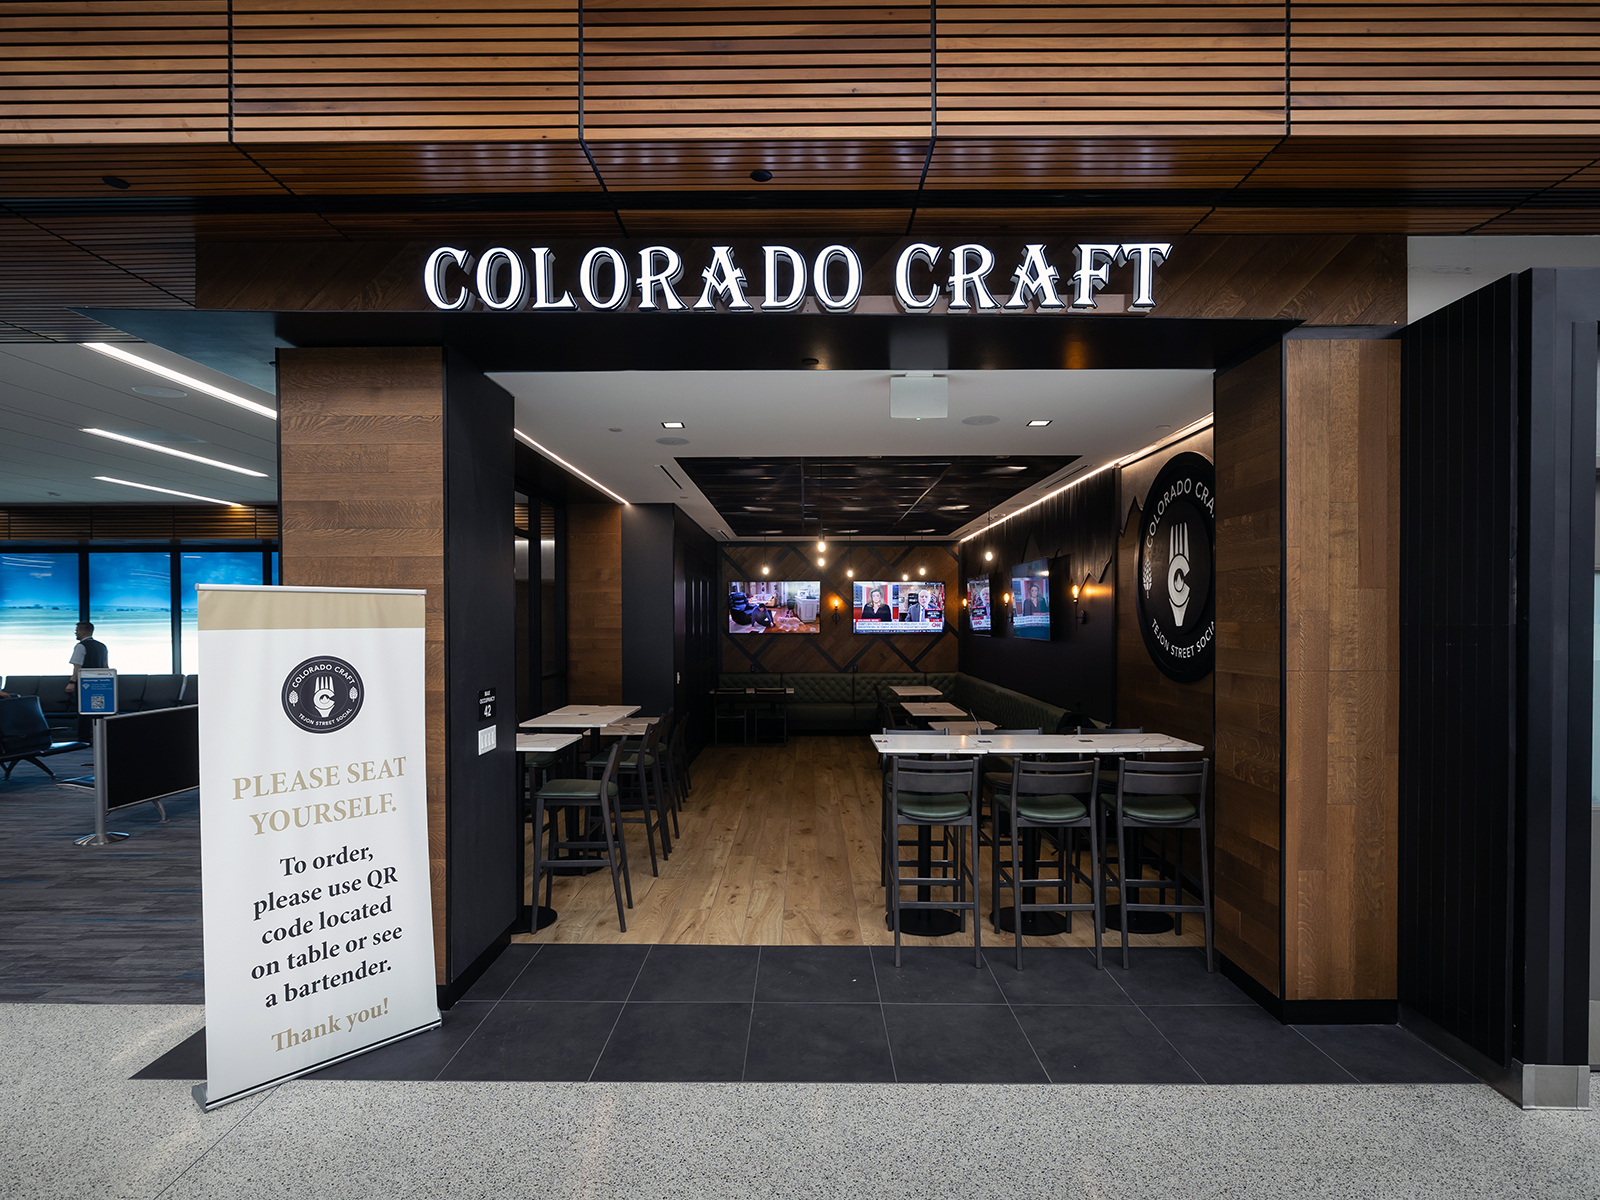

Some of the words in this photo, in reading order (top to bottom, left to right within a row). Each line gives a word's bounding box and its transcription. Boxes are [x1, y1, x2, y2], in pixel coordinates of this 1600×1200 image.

[423, 245, 864, 312] COLORADO
[895, 243, 1173, 312] CRAFT
[1146, 477, 1192, 548] COLORADO
[1194, 481, 1215, 519] CRA
[1151, 618, 1170, 651] TEJON
[1170, 645, 1195, 658] STREET
[292, 664, 333, 688] COLORADO
[334, 666, 356, 684] CRAFT
[298, 713, 315, 725] TEJON
[335, 708, 353, 722] SOCIAL
[484, 705, 491, 717] 42
[232, 765, 341, 800] PLEASE
[346, 756, 407, 784] SEAT
[249, 793, 397, 836] YOURSELF.
[280, 856, 307, 877] To
[312, 845, 374, 871] order,
[253, 886, 322, 921] please
[328, 877, 362, 898] use
[366, 866, 398, 889] QR
[261, 917, 314, 945] code
[319, 895, 393, 930] located
[251, 960, 280, 980] on
[286, 940, 340, 970] table
[345, 935, 368, 953] or
[372, 926, 403, 946] see
[265, 992, 278, 1008] a
[283, 959, 392, 1002] bartender.
[271, 1014, 342, 1052] Thank
[345, 997, 390, 1032] you!
